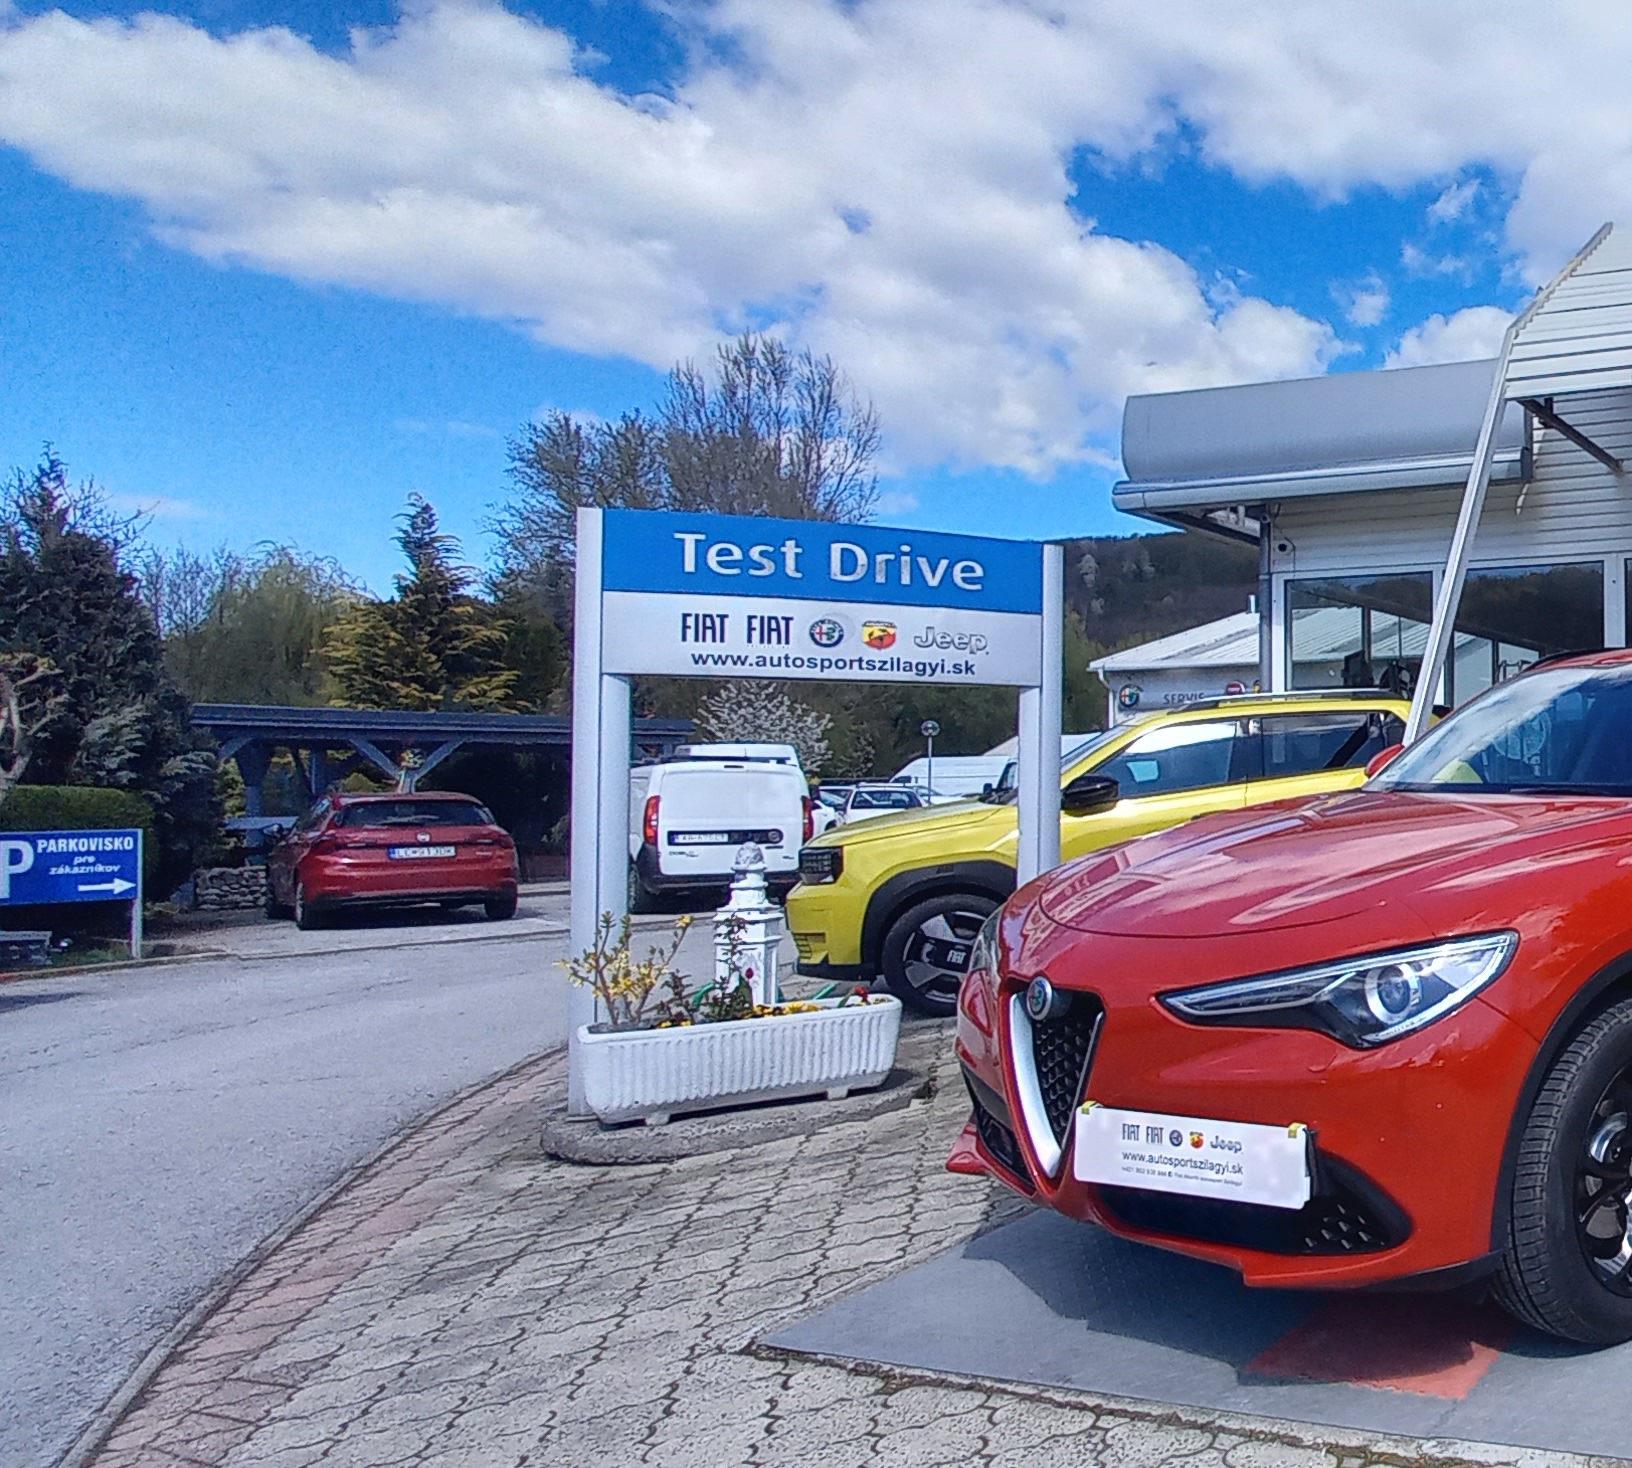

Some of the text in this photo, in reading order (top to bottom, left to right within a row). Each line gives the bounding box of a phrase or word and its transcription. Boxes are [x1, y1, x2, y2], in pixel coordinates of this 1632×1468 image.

[673, 532, 985, 591] Test Drive
[681, 612, 729, 645] FIAT
[746, 614, 794, 646] FIAT
[913, 626, 987, 655] Jeep
[691, 652, 976, 677] www.autosportszilagyi.sk
[36, 837, 134, 853] PARKOVISKO
[0, 840, 35, 898] P
[48, 863, 121, 875] zákazníkov
[73, 855, 96, 865] pre
[946, 949, 967, 965] FIAT
[1122, 1123, 1141, 1142] FIAT
[1146, 1125, 1164, 1145] FIAT
[1121, 1151, 1244, 1176] www.autosportszilagyi.sk
